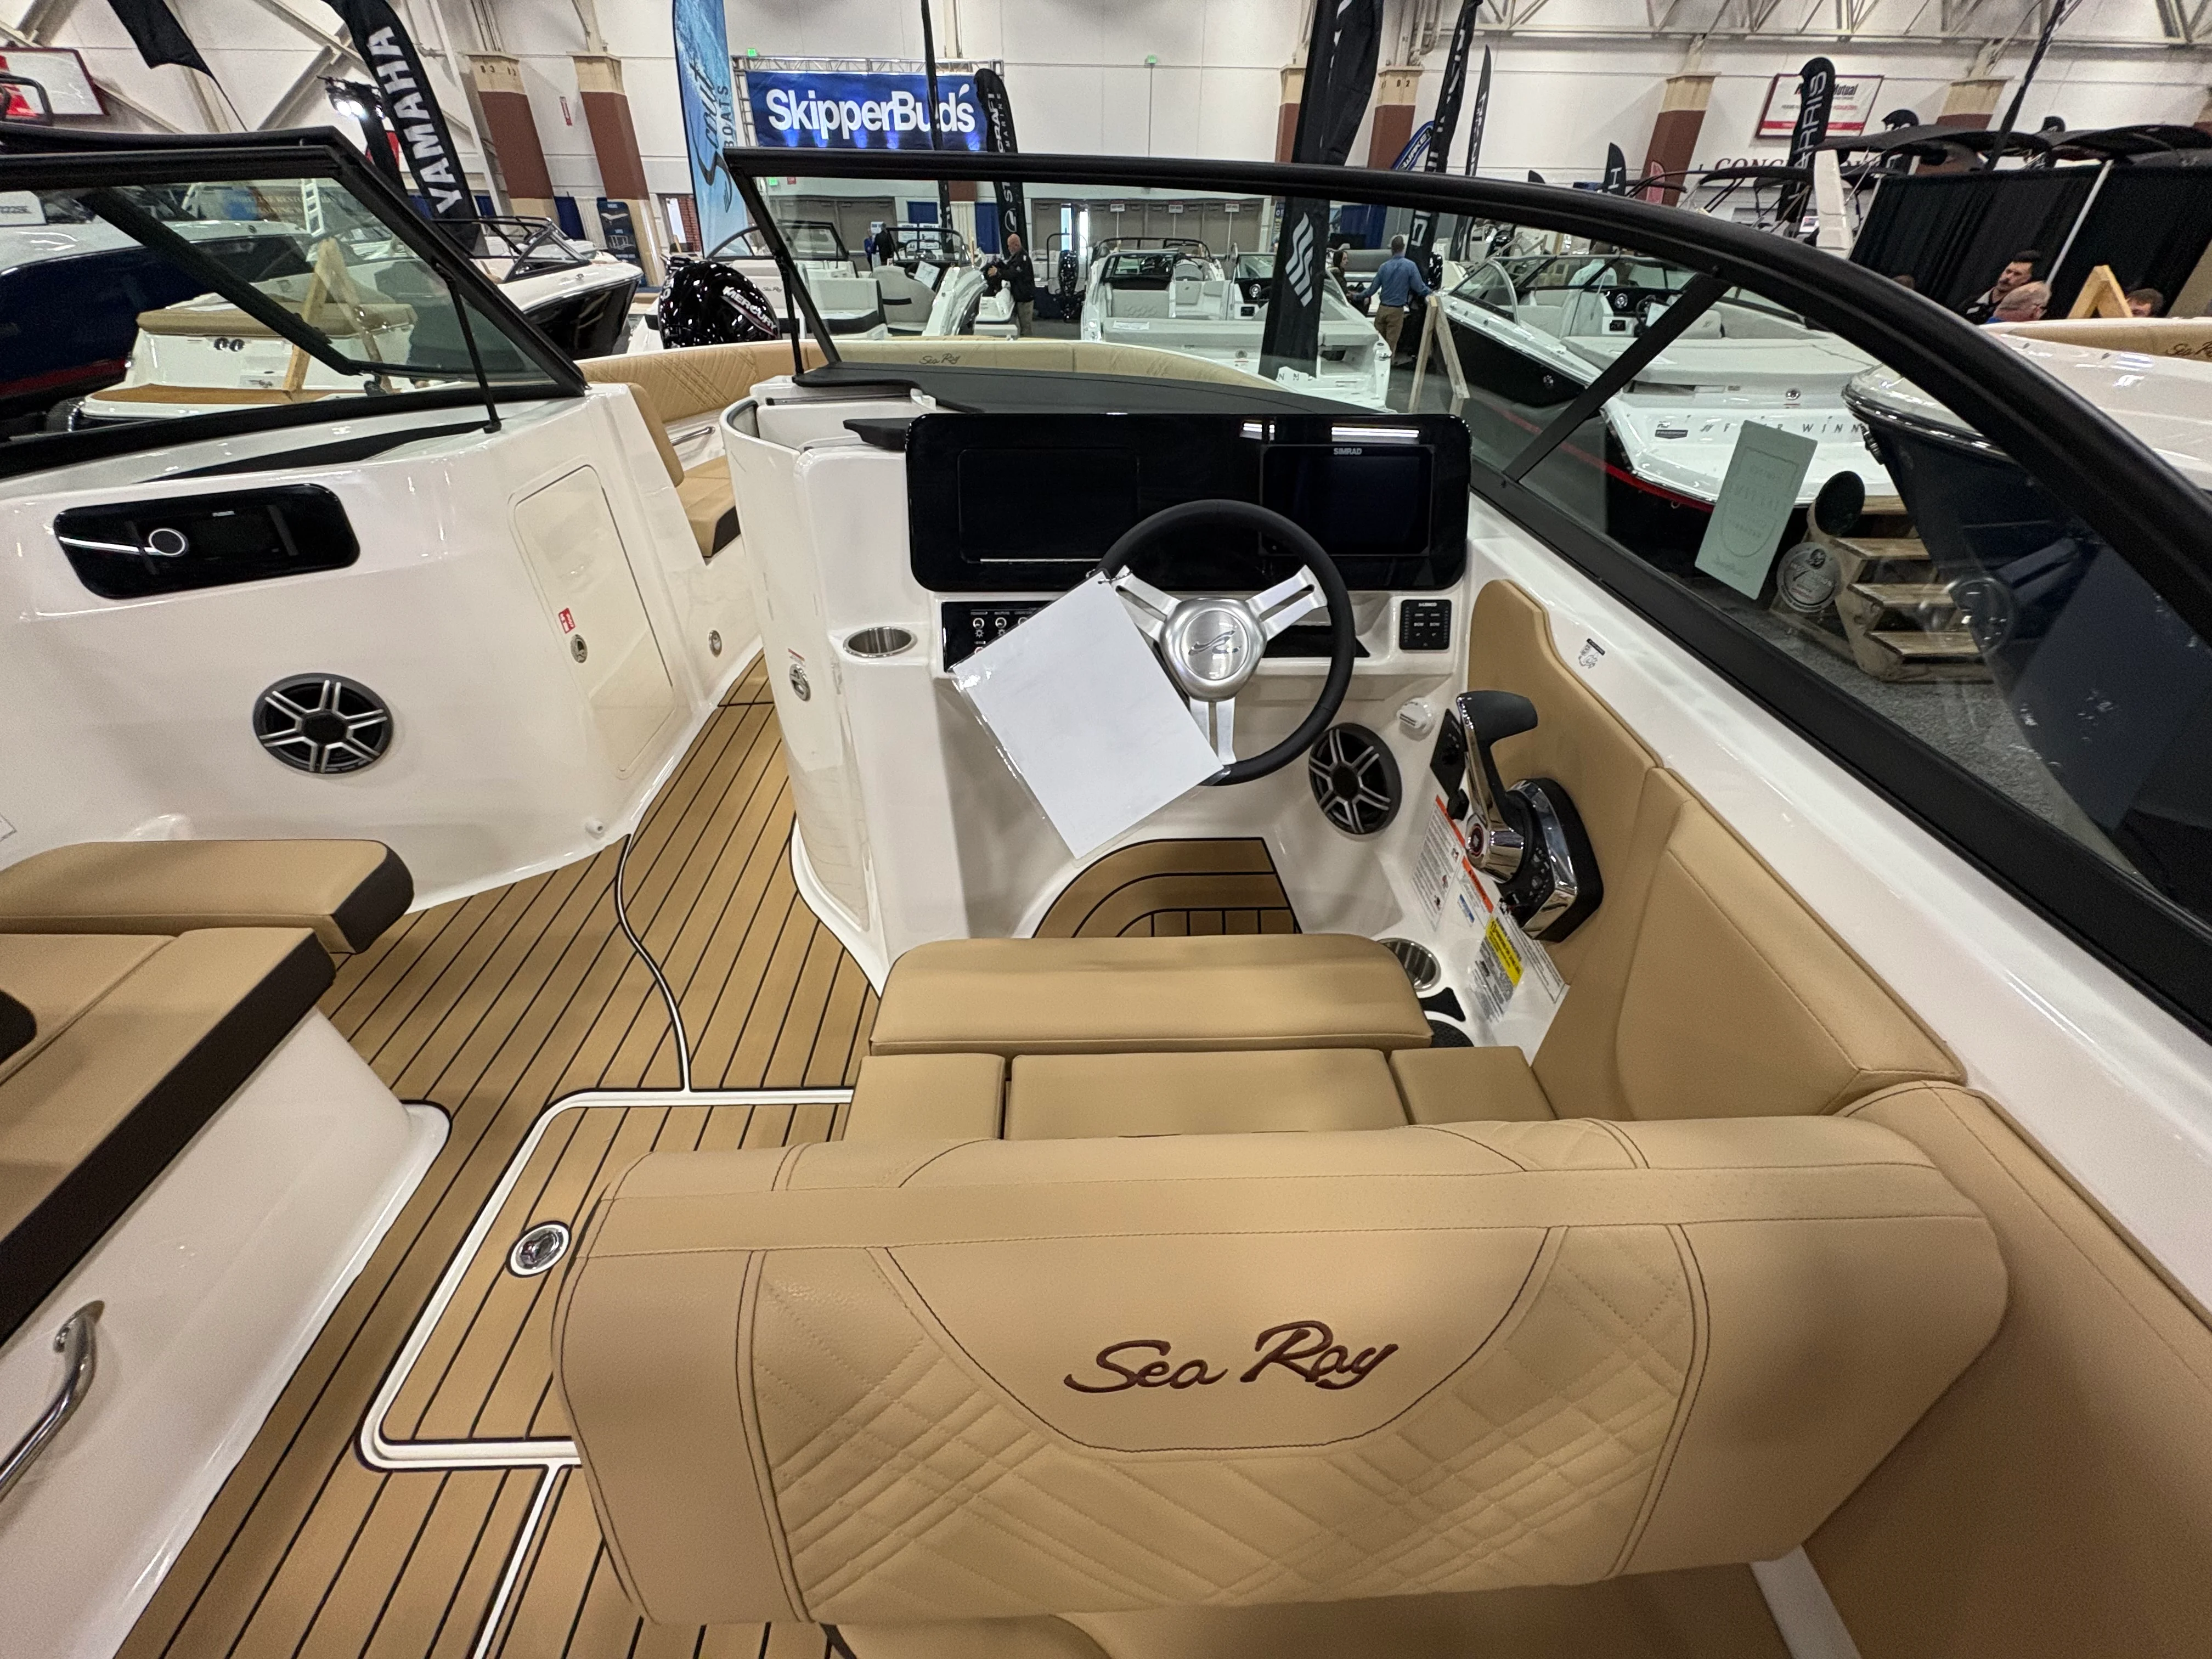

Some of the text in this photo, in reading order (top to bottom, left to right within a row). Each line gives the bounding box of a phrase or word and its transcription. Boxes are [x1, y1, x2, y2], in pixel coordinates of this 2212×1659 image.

[368, 26, 462, 214] YAMAHA
[689, 53, 733, 213] Scout
[717, 85, 735, 148] BOATS
[996, 93, 1011, 148] MARINE
[722, 285, 778, 330] MERCURY
[918, 353, 961, 365] Sea Ray
[1333, 447, 1363, 455] SIMRAD
[1802, 423, 1863, 433] WINN
[1063, 1319, 1400, 1394] Sea Ray
